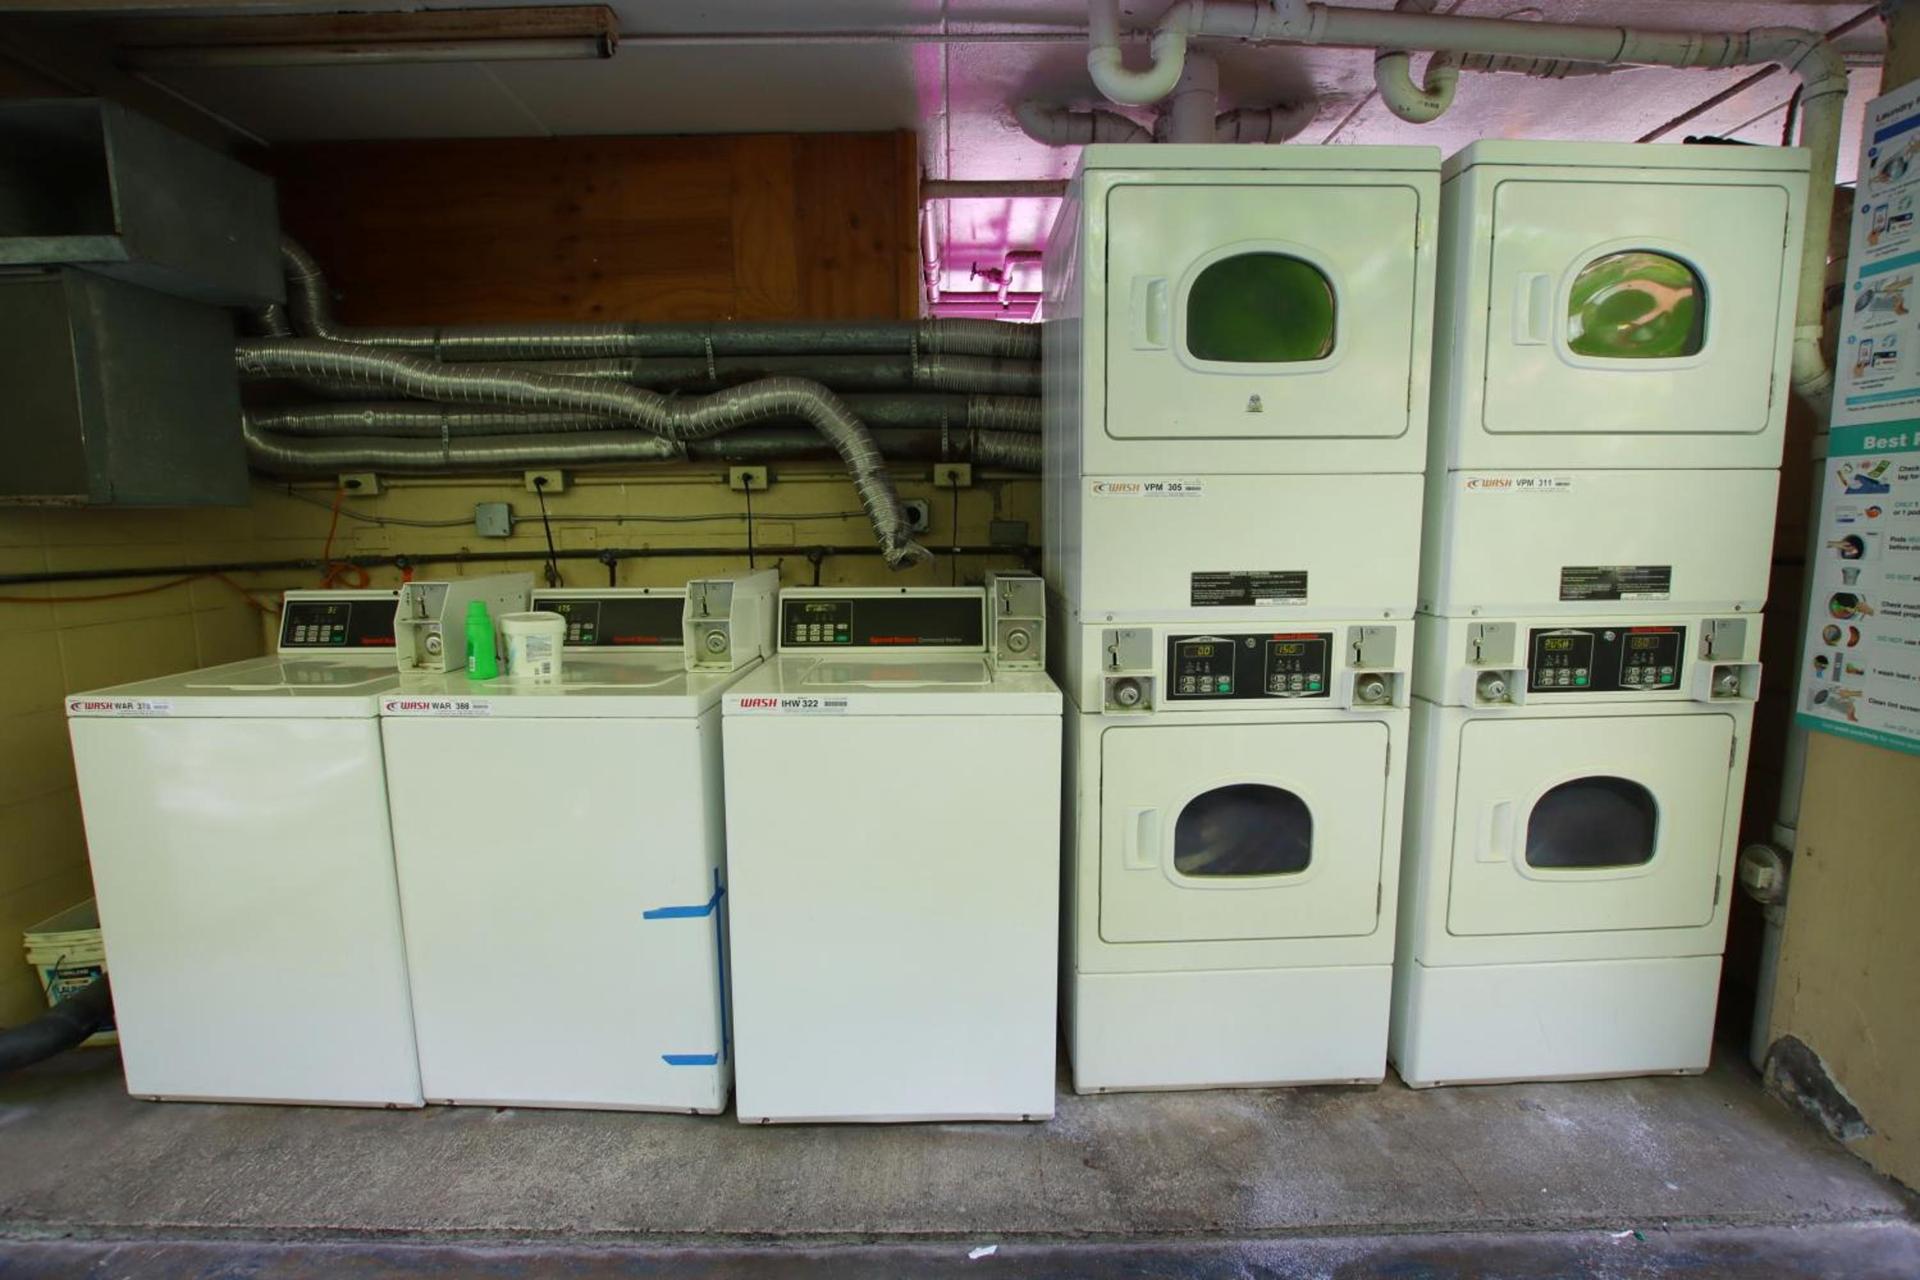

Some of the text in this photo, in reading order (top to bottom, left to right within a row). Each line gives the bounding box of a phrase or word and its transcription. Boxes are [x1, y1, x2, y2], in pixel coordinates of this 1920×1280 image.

[1876, 101, 1914, 122] Laundry
[1863, 434, 1907, 449] Best
[1108, 482, 1182, 492] WASH VPM 305
[1481, 479, 1512, 488] WASH
[1516, 479, 1534, 487] VPM
[84, 701, 113, 710] WASH
[115, 702, 134, 710] WAR
[400, 701, 430, 710] WASH
[432, 702, 451, 710] WAR
[740, 698, 819, 708] WASH IHW 322
[1868, 697, 1886, 706] Clean
